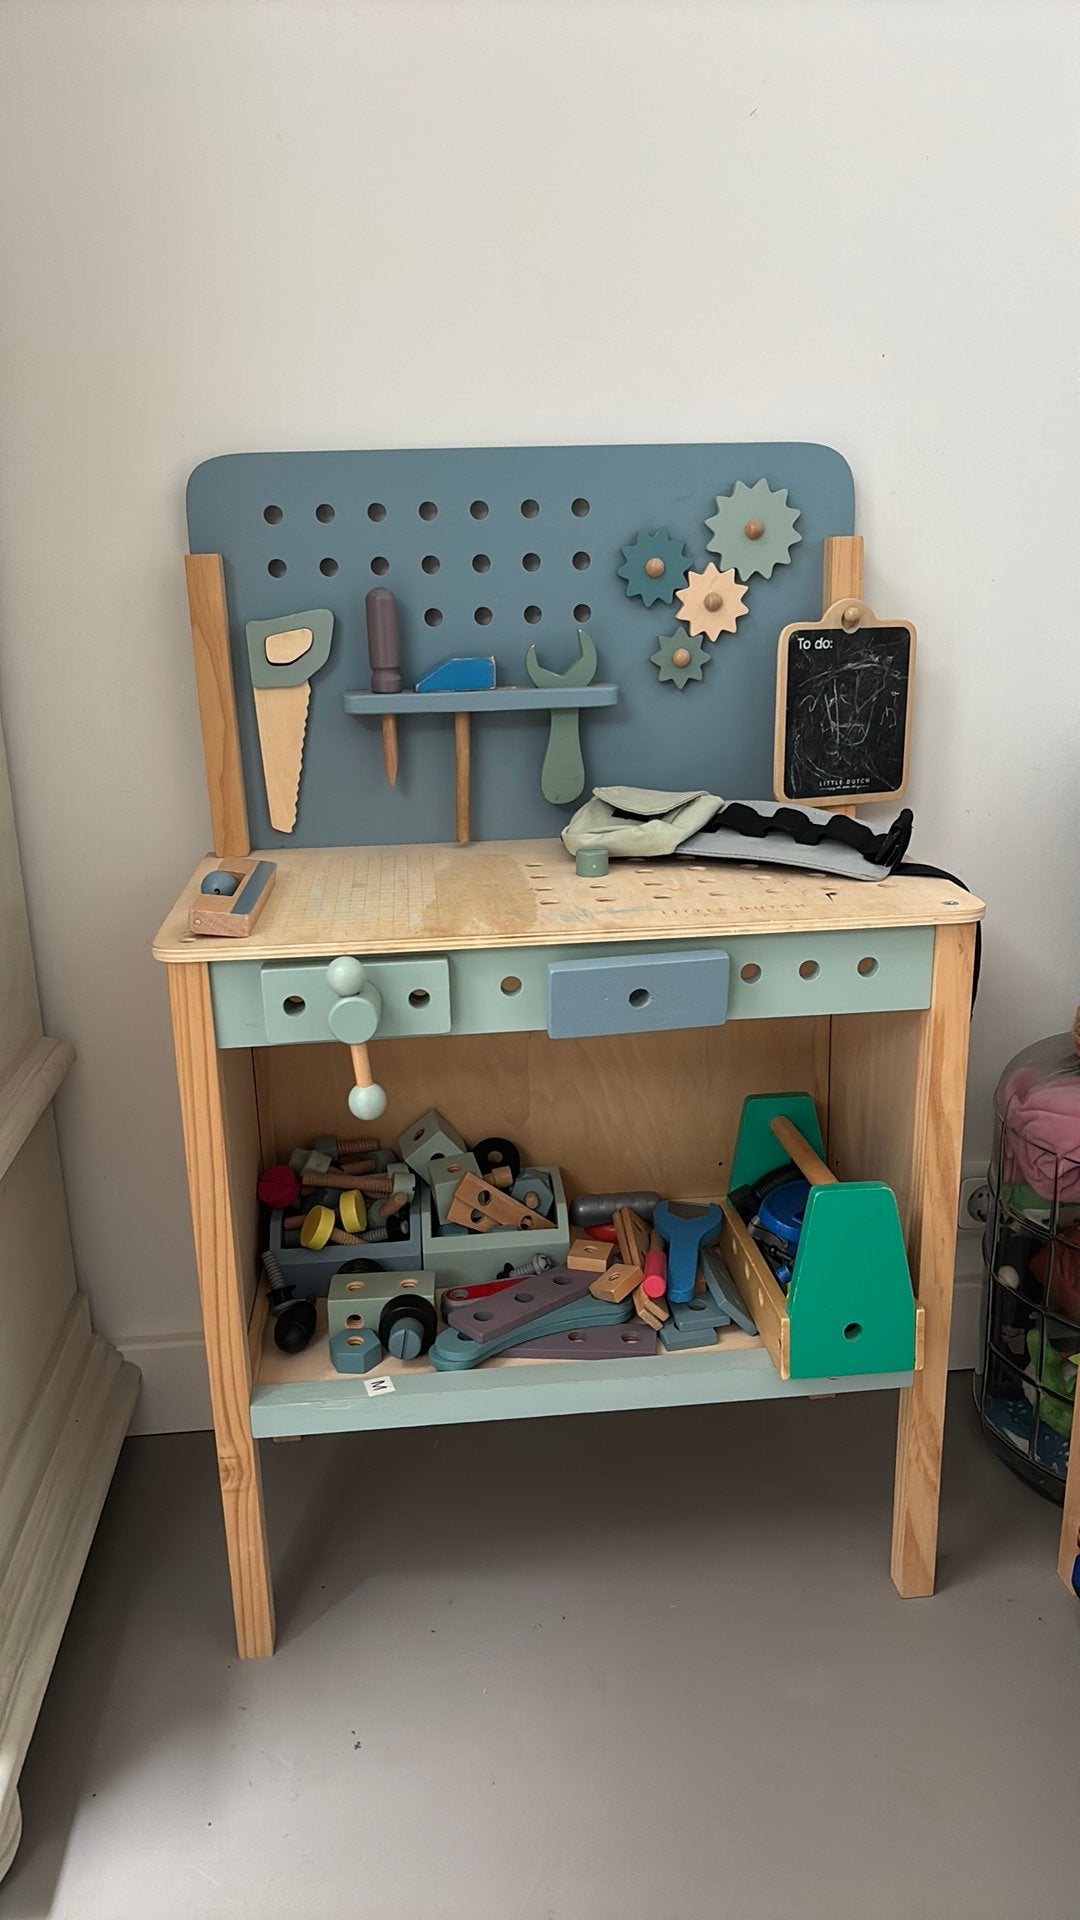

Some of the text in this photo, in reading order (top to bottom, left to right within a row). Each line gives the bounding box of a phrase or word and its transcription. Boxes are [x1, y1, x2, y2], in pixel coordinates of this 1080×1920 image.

[797, 637, 833, 650] To do:
[819, 777, 871, 787] LITTLE DUTCH
[370, 1380, 388, 1391] M
